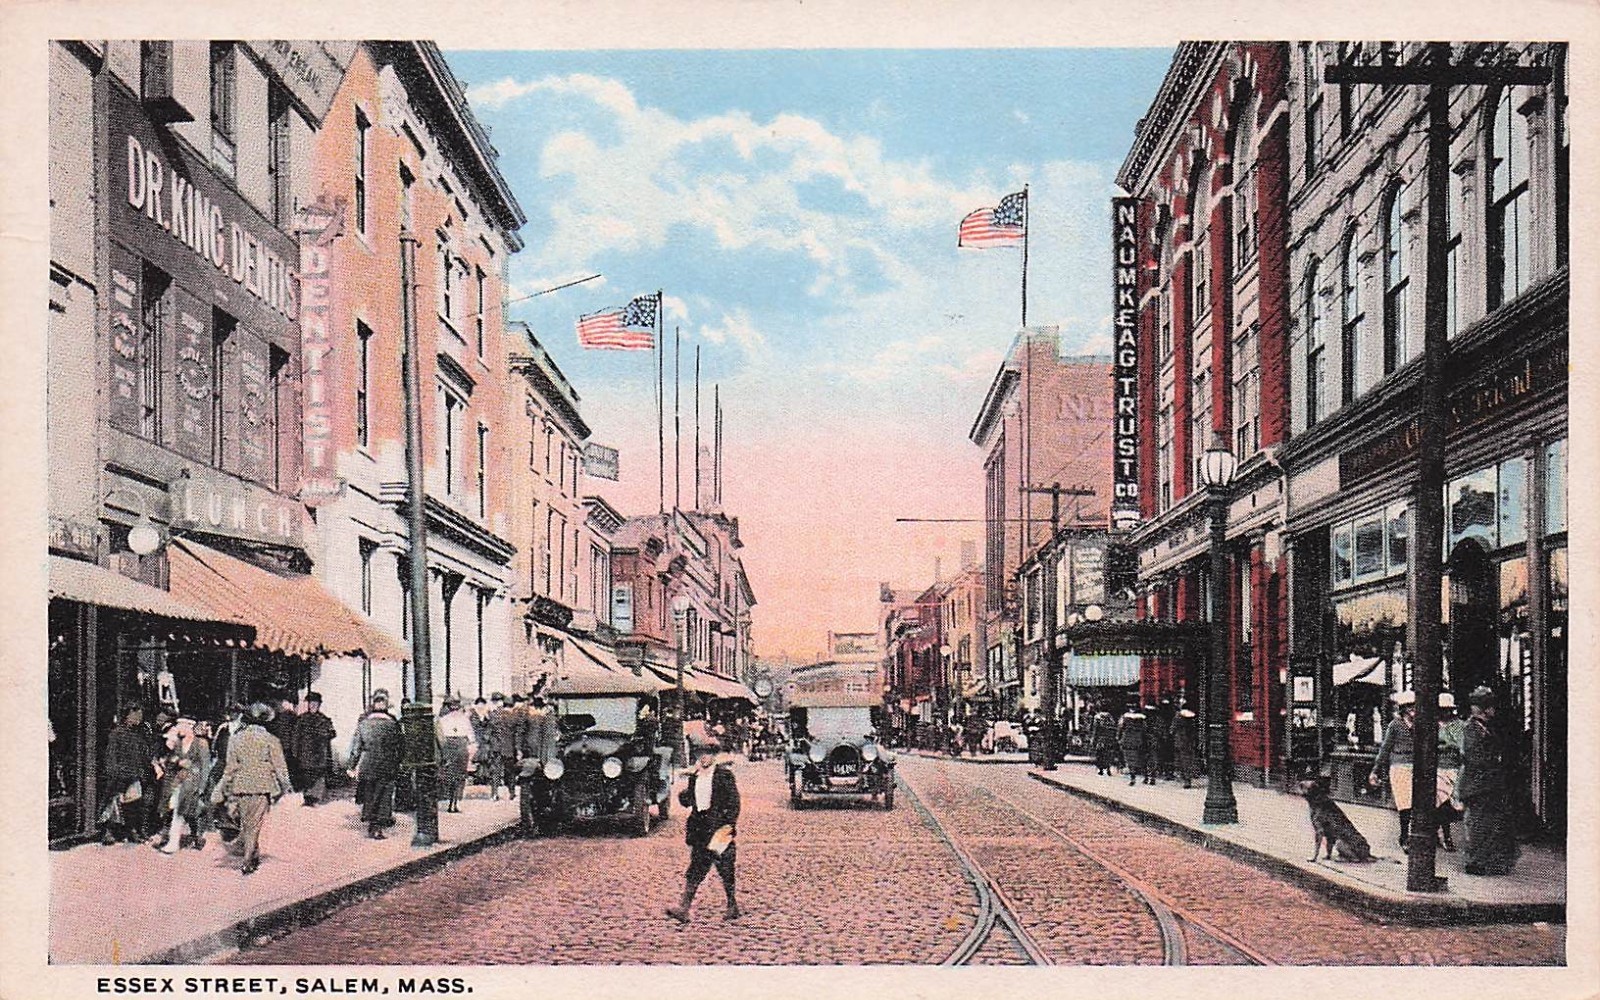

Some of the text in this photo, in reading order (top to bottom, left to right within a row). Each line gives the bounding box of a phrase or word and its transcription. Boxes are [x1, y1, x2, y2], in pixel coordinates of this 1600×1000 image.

[1117, 205, 1136, 368] NAUMKEAG
[1118, 377, 1136, 475] TRUST
[186, 487, 291, 538] LUNCH
